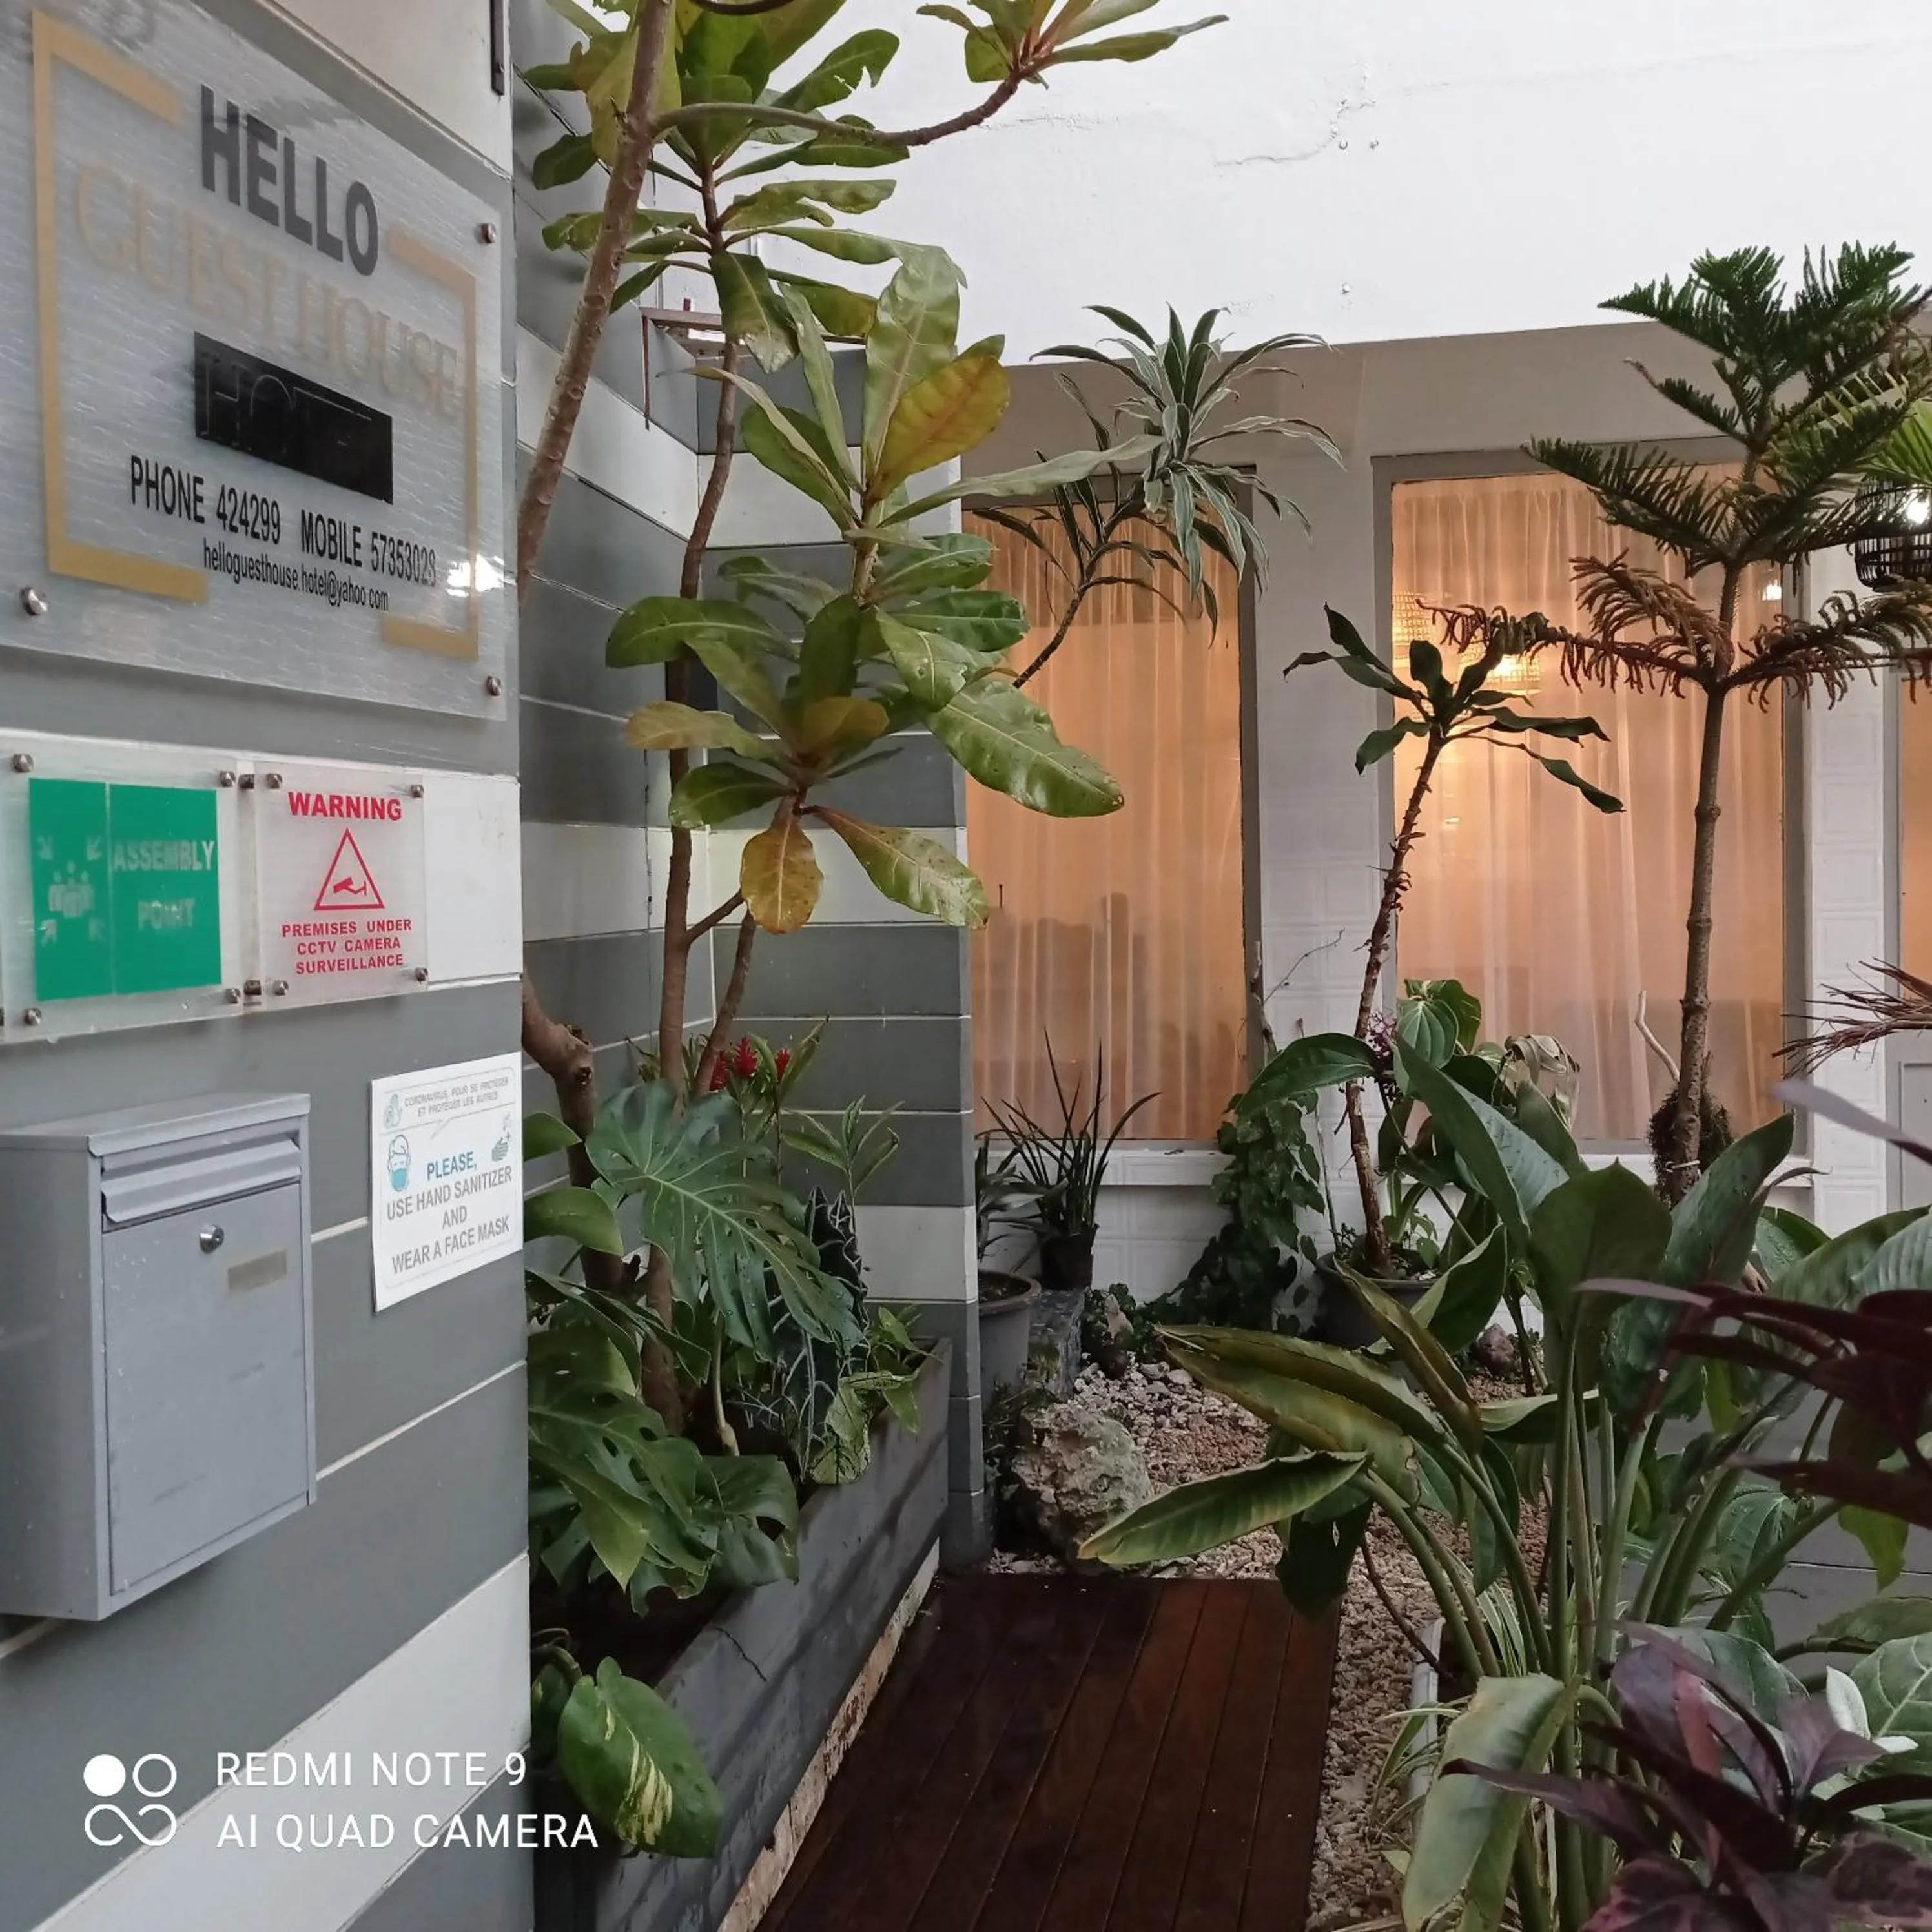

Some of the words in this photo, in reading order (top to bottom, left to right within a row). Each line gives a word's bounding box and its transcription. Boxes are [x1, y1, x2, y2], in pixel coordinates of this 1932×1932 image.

[200, 83, 378, 276] HELLO
[131, 455, 205, 524] PHONE
[216, 484, 280, 545] 424299
[300, 509, 363, 568] MOBILE
[203, 537, 389, 611] helloguesthouse.hotel@yahoocom
[287, 791, 402, 821] WARNING
[112, 840, 215, 871] ASSEMBLY
[282, 921, 357, 937] PREMISES
[367, 919, 412, 933] UNDER
[297, 941, 337, 955] CCTV
[345, 937, 401, 952] CAMERA
[296, 954, 404, 974] SURVEILLANCE
[463, 1096, 474, 1107] LES
[470, 1084, 479, 1093] SE
[427, 1151, 477, 1181] PLEASE,
[387, 1196, 413, 1220] USE
[416, 1184, 451, 1211] HAND
[454, 1166, 512, 1199] SANITIZER
[442, 1205, 468, 1230] AND
[391, 1244, 430, 1275] WEAR
[433, 1240, 442, 1260] A
[445, 1228, 475, 1255] FACE
[478, 1215, 509, 1243] MASK
